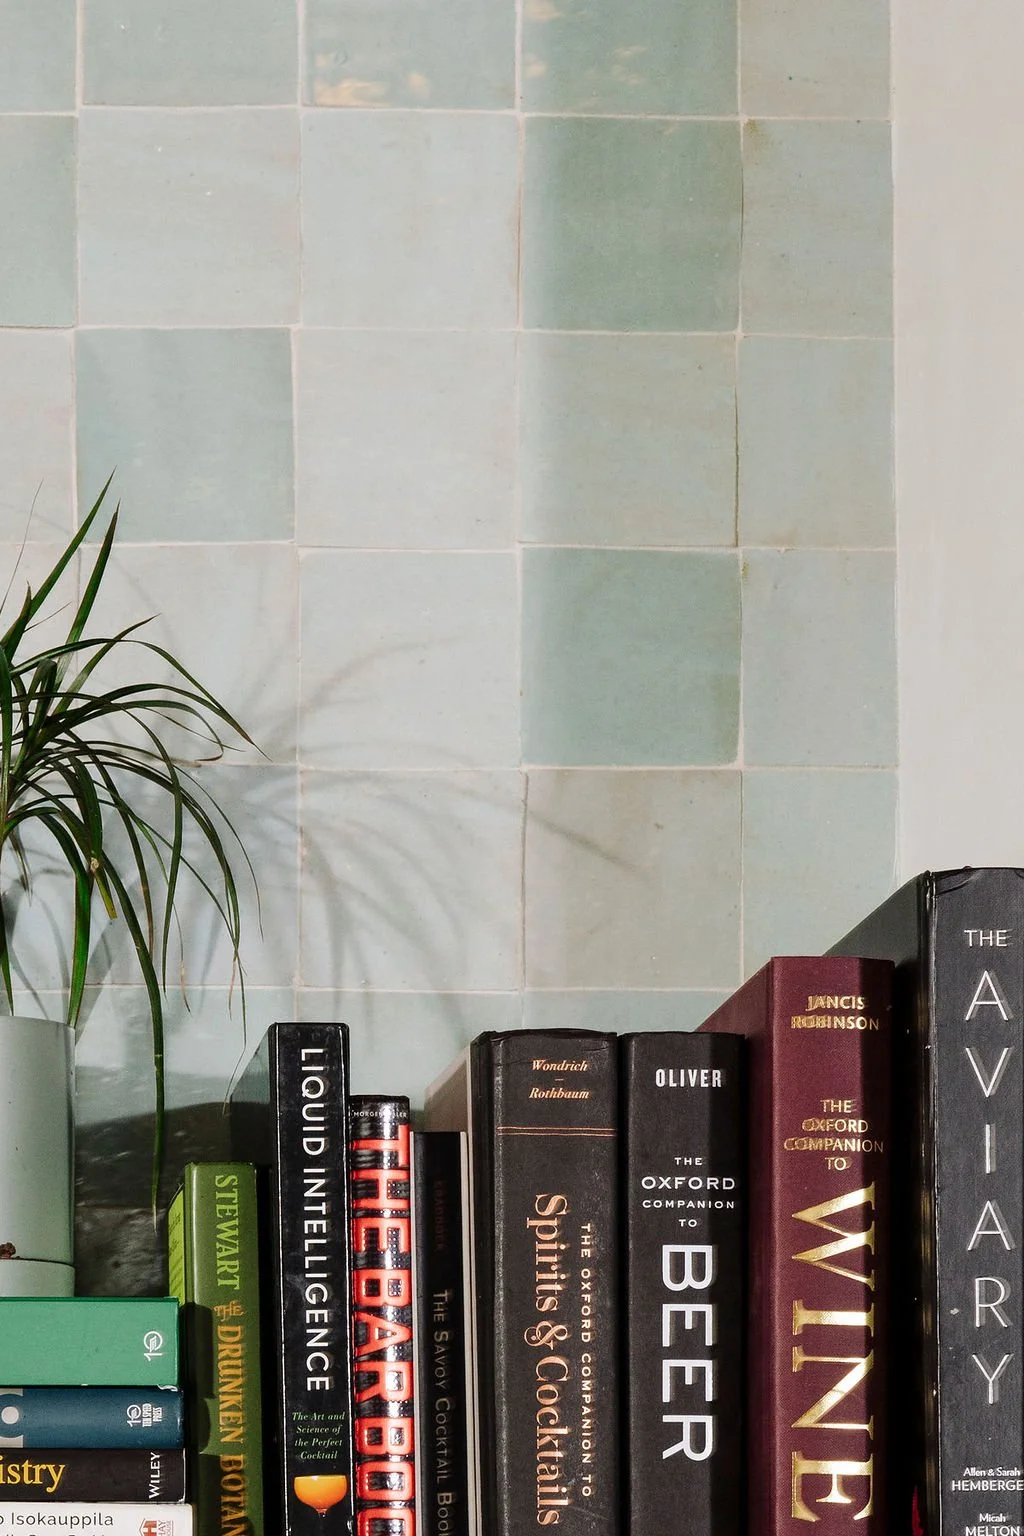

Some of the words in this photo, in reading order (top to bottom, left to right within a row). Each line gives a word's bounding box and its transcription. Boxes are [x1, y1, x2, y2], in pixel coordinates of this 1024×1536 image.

[964, 928, 1007, 948] THE
[805, 996, 865, 1011] JANCIS
[791, 1015, 880, 1031] ROBINSON
[532, 1059, 588, 1071] Wondrich
[655, 1068, 722, 1088] OLIVER
[529, 1087, 590, 1099] Rothbaum
[301, 1048, 325, 1156] LIQUID
[820, 1099, 853, 1113] THE
[801, 1118, 868, 1133] OXFORD
[783, 1137, 884, 1153] COMPANION
[674, 1157, 703, 1165] THE
[824, 1157, 847, 1171] TO
[351, 1124, 411, 1254] THE
[641, 1176, 736, 1190] OXFORD
[964, 970, 1011, 1405] AVIARY
[642, 1200, 735, 1209] COMPANION
[678, 1219, 698, 1227] TO
[214, 1174, 240, 1290] STEWART
[581, 1223, 591, 1258] THE
[527, 1193, 569, 1312] Spirits
[303, 1168, 329, 1391] INTELLIGENCE
[581, 1268, 591, 1343] OXFORD
[353, 1269, 413, 1402] BAR
[524, 1320, 568, 1350] &
[662, 1244, 713, 1461] BEER
[791, 1181, 876, 1523] WINE
[216, 1325, 245, 1444] DRUNKEN
[292, 1412, 308, 1420] The
[311, 1412, 325, 1420] Art
[328, 1411, 345, 1420] and
[581, 1353, 591, 1464] COMPANION
[296, 1425, 329, 1433] Science
[332, 1424, 343, 1435] of
[294, 1438, 308, 1446] the
[311, 1437, 342, 1449] Perfect
[535, 1355, 569, 1526] Cocktails
[300, 1450, 337, 1459] Cocktail
[148, 1451, 161, 1499] WILEY
[963, 1467, 986, 1476] Allen
[987, 1468, 995, 1476] &
[996, 1466, 1021, 1476] Sarah
[581, 1474, 592, 1497] TO
[11, 1512, 114, 1529] Isokauppila
[979, 1513, 1006, 1522] Micah
[965, 1526, 1021, 1536] MELTON
